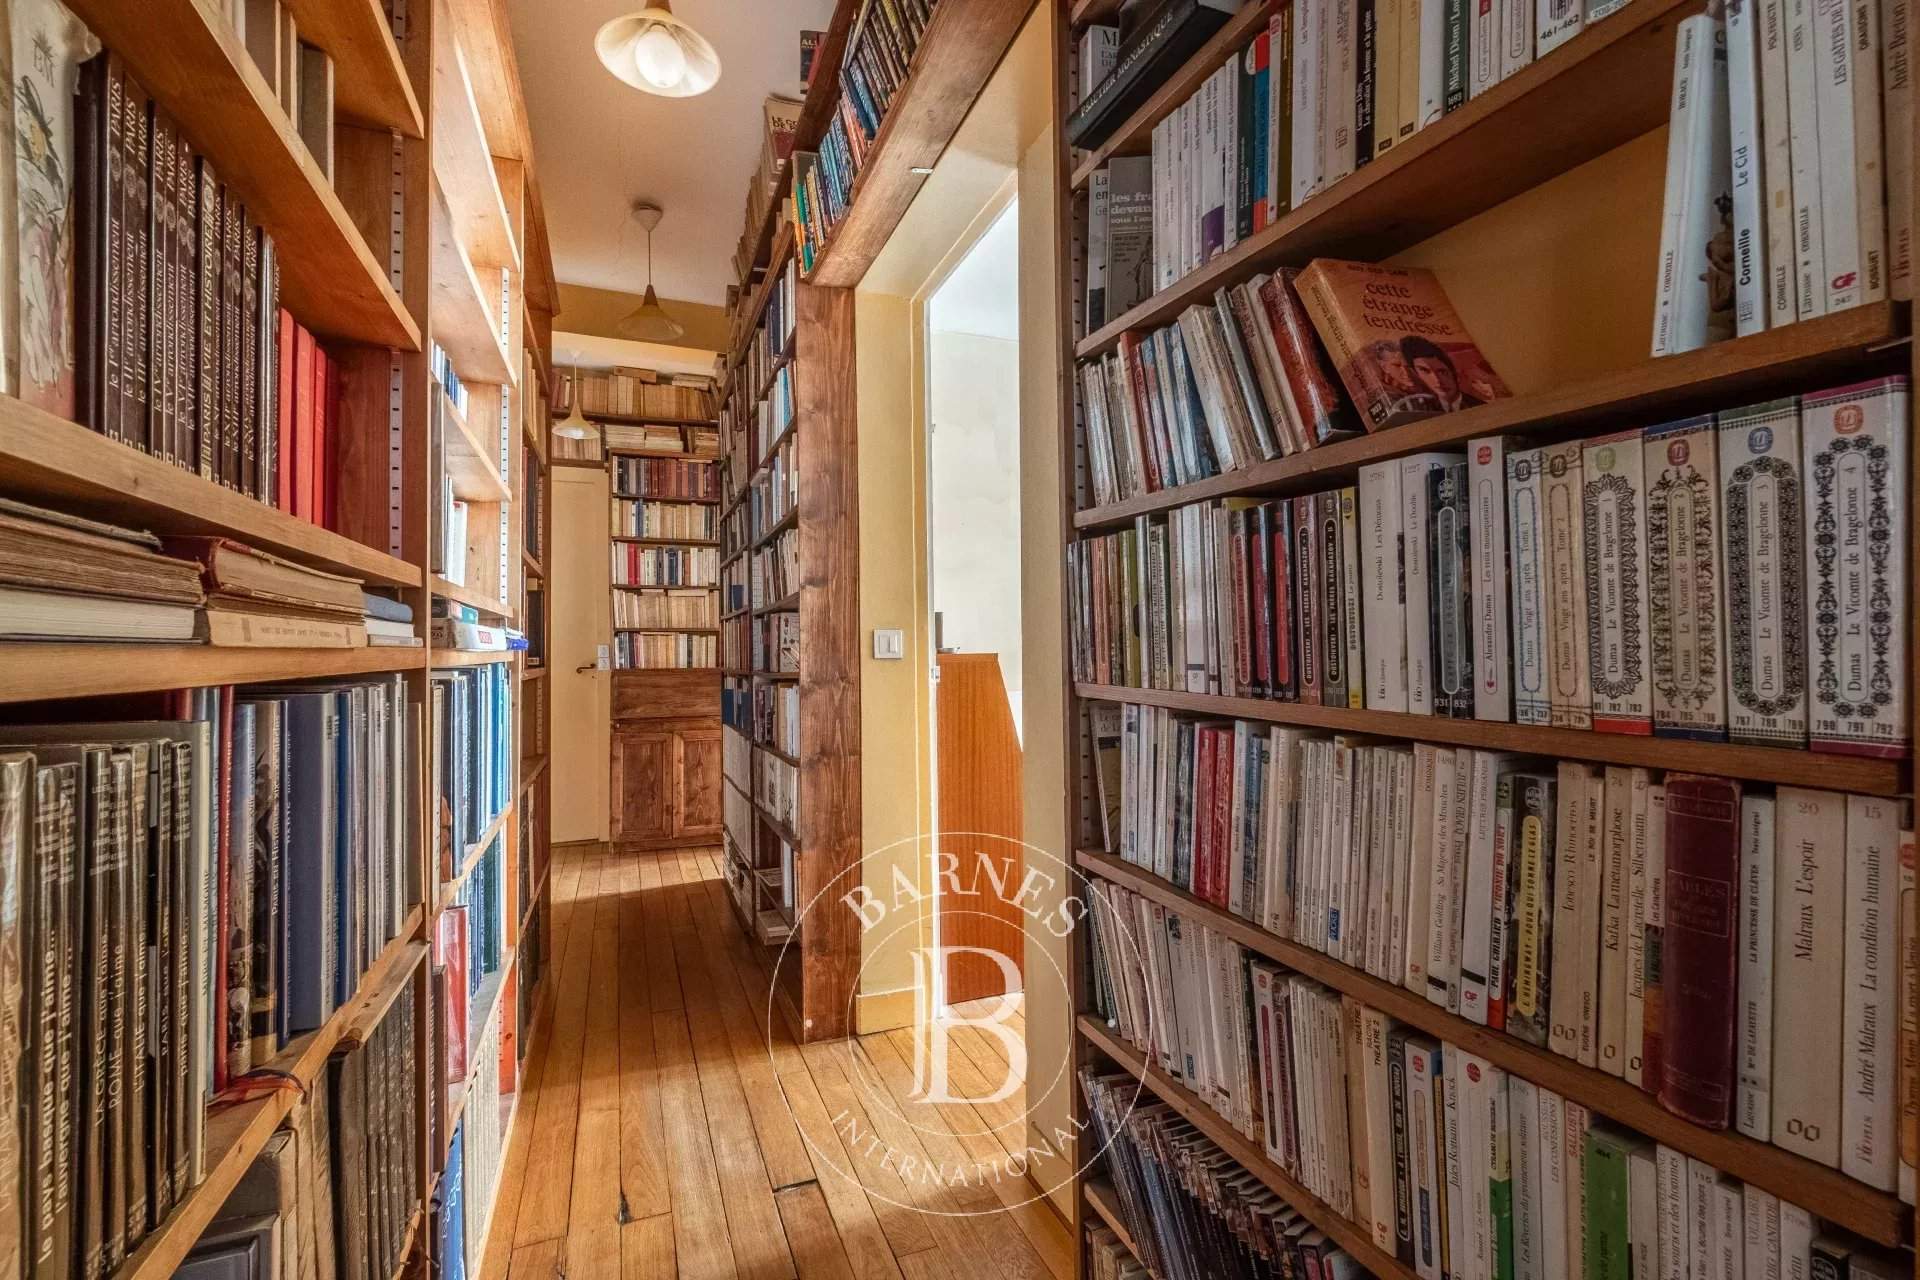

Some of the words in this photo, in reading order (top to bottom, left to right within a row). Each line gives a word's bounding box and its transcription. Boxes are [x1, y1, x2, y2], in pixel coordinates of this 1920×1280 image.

[1767, 1, 1778, 50] POLYEUCTE
[1832, 9, 1845, 25] DE
[1890, 4, 1908, 47] Breton
[1834, 66, 1847, 86] LES
[1890, 53, 1908, 91] André
[111, 77, 121, 136] PARIS
[125, 97, 136, 154] PARIS
[138, 111, 147, 168] PARIS
[155, 128, 164, 182] PARIS
[167, 139, 175, 192] PARIS
[1735, 145, 1748, 168] Cid
[179, 156, 187, 207] PARIS
[187, 168, 196, 218] PARIS
[1662, 249, 1674, 292] CORNEILLE
[1678, 77, 1689, 110] HORACE
[1736, 172, 1748, 187] Le
[1799, 206, 1810, 252] CORNEILLE
[203, 223, 214, 309] HISTOIRE
[1737, 228, 1752, 286] Corneille
[110, 218, 121, 347] arrondissement
[124, 232, 136, 356] arrondissement
[137, 229, 148, 352] arrondissement
[1365, 281, 1412, 298] cette
[1776, 265, 1786, 311] CORNEILLE
[154, 248, 164, 368] arrondissement
[166, 262, 175, 377] arrondissement
[179, 264, 187, 376] arrondissement
[203, 311, 212, 336] ET
[1362, 294, 1435, 320] étrange
[1363, 312, 1453, 336] tendresse
[203, 340, 212, 370] VIE
[109, 374, 119, 388] le
[124, 386, 134, 397] le
[137, 389, 146, 403] le
[154, 399, 163, 411] le
[166, 403, 174, 415] le
[179, 412, 186, 423] le
[203, 393, 212, 444] PARIS
[1481, 496, 1492, 551] mousquetaires
[1674, 506, 1689, 557] Bragelonne
[1757, 501, 1772, 556] Bragelonne
[1844, 487, 1863, 546] Bragelonne
[1520, 530, 1530, 552] Tome
[1557, 527, 1566, 551] Tome
[1602, 512, 1616, 559] Bragelonne
[1522, 564, 1533, 584] après
[1559, 563, 1570, 585] après
[1604, 563, 1615, 572] de
[1676, 563, 1688, 572] de
[1757, 561, 1770, 575] de
[1844, 552, 1859, 566] de
[1483, 571, 1491, 582] Les
[1845, 572, 1860, 615] Vicomte
[1484, 594, 1492, 621] Dumas
[1559, 589, 1568, 603] ans
[1604, 578, 1616, 613] Vicomte
[1677, 577, 1689, 616] Vicomte
[1758, 579, 1771, 620] Vicomte
[1524, 607, 1535, 629] Vingt
[1559, 607, 1571, 630] Vingt
[1606, 617, 1617, 629] Le
[1679, 620, 1690, 634] Le
[1758, 626, 1771, 639] Le
[1846, 622, 1861, 635] Le
[1485, 623, 1493, 661] Alexandre
[1525, 640, 1534, 667] Dumas
[1561, 641, 1571, 670] Dumas
[1607, 643, 1618, 673] Dumas
[1680, 649, 1691, 682] Dumas
[1761, 656, 1773, 690] Dumas
[1847, 654, 1862, 691] Dumas
[1816, 720, 1836, 730] 790
[1848, 722, 1864, 733] 791
[1876, 723, 1893, 735] 792
[1439, 784, 1449, 823] Mouches
[1439, 825, 1447, 839] des
[1528, 824, 1536, 845] GLAS
[1632, 813, 1645, 877] Silbermann
[1436, 842, 1449, 874] Majesté
[1529, 849, 1535, 859] LE
[1608, 808, 1624, 892] métamorphose
[1795, 838, 1819, 895] L'espoir
[1436, 877, 1445, 886] Sa
[1527, 862, 1535, 890] SONNE
[1562, 870, 1576, 911] Ionesco
[1861, 846, 1880, 904] humaine
[1435, 894, 1445, 928] Golding
[1526, 893, 1534, 908] QUI
[1606, 895, 1620, 909] La
[1632, 885, 1644, 939] Lacretelle
[1492, 917, 1501, 961] GUIMARD
[1525, 912, 1534, 935] POUR
[1605, 916, 1619, 951] Kafka
[1795, 904, 1813, 961] Malraux
[1859, 908, 1878, 970] condition
[1434, 931, 1443, 962] William
[1631, 942, 1643, 956] de
[41, 929, 56, 1023] j'aime...
[1491, 965, 1499, 988] PAUL
[1522, 944, 1534, 996] HEMINGWAY
[1630, 958, 1645, 1000] Jacques
[1859, 972, 1877, 991] La
[97, 989, 109, 1021] que
[135, 990, 146, 1017] que
[112, 1008, 124, 1040] que
[1860, 1003, 1879, 1056] Malraux
[41, 1037, 56, 1075] que
[93, 1028, 107, 1096] GRÈCE
[134, 1027, 145, 1094] L'ITALIE
[57, 1058, 71, 1093] que
[109, 1051, 122, 1110] ROME
[1858, 1059, 1877, 1102] André
[1446, 1077, 1457, 1110] Knock
[37, 1081, 56, 1171] basque
[94, 1096, 105, 1126] LA
[1447, 1118, 1458, 1162] Romains
[1518, 1114, 1528, 1147] solitaire
[1567, 1105, 1578, 1158] SALLUSTE
[55, 1099, 70, 1214] l'auvergne
[1448, 1164, 1460, 1188] Jules
[1519, 1150, 1530, 1199] promeneur
[1669, 1156, 1679, 1202] hommes
[40, 1175, 56, 1230] pays
[1519, 1201, 1529, 1211] du
[1669, 1204, 1680, 1219] des
[1519, 1213, 1530, 1245] Rêveries
[1669, 1222, 1680, 1234] et
[1748, 1194, 1759, 1246] VOLTAIRE
[1766, 1201, 1777, 1254] CANDIDE
[37, 1235, 54, 1264] le
[1521, 1248, 1530, 1264] Les
[1668, 1237, 1680, 1266] souris
